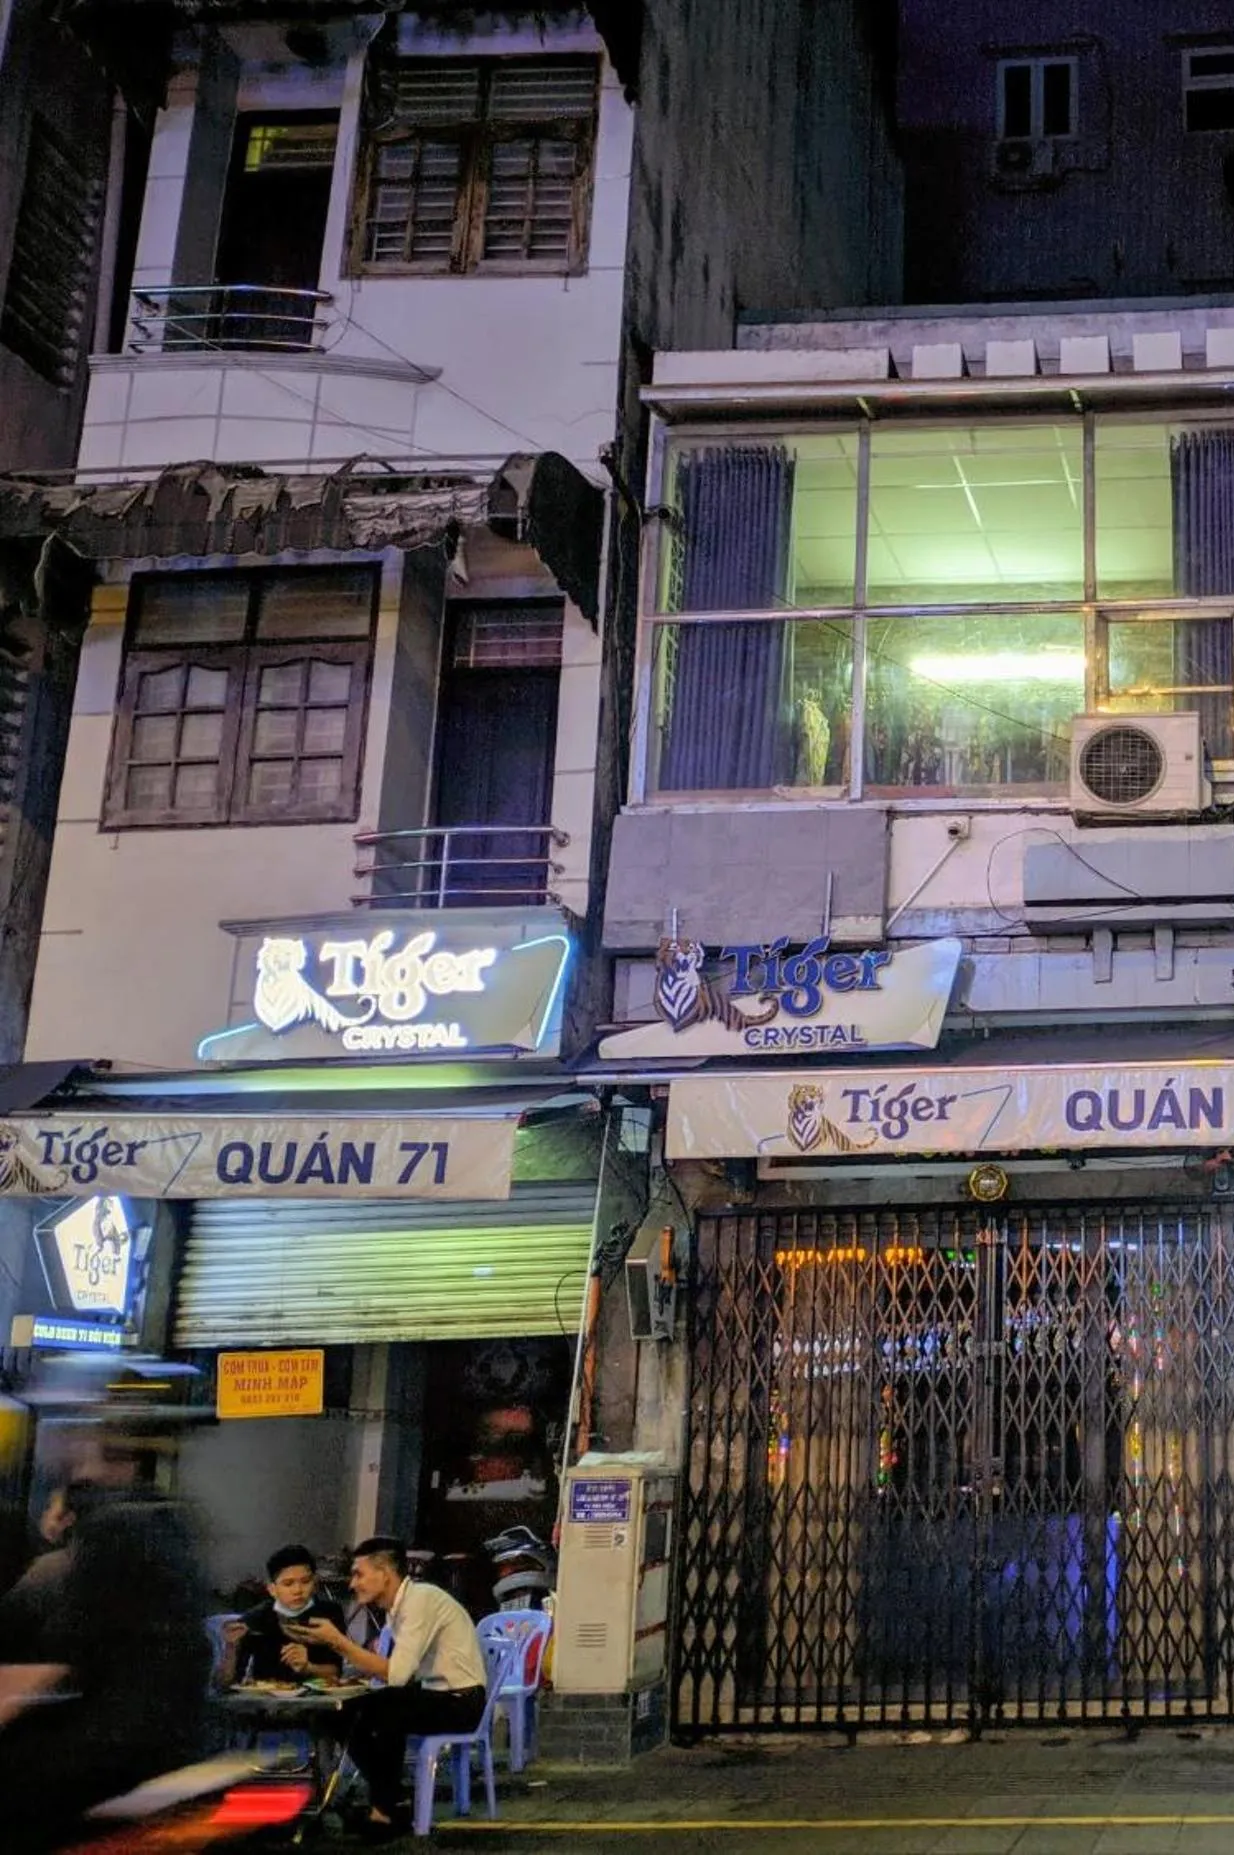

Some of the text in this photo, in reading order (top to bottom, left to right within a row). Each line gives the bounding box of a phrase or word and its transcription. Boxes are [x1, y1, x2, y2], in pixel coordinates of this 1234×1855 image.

[343, 1025, 468, 1051] CRYSTAL
[744, 1024, 865, 1050] CRYSTAL
[1065, 1077, 1224, 1132] QUÁN
[217, 1131, 376, 1185] QUÁN
[397, 1141, 450, 1185] 71
